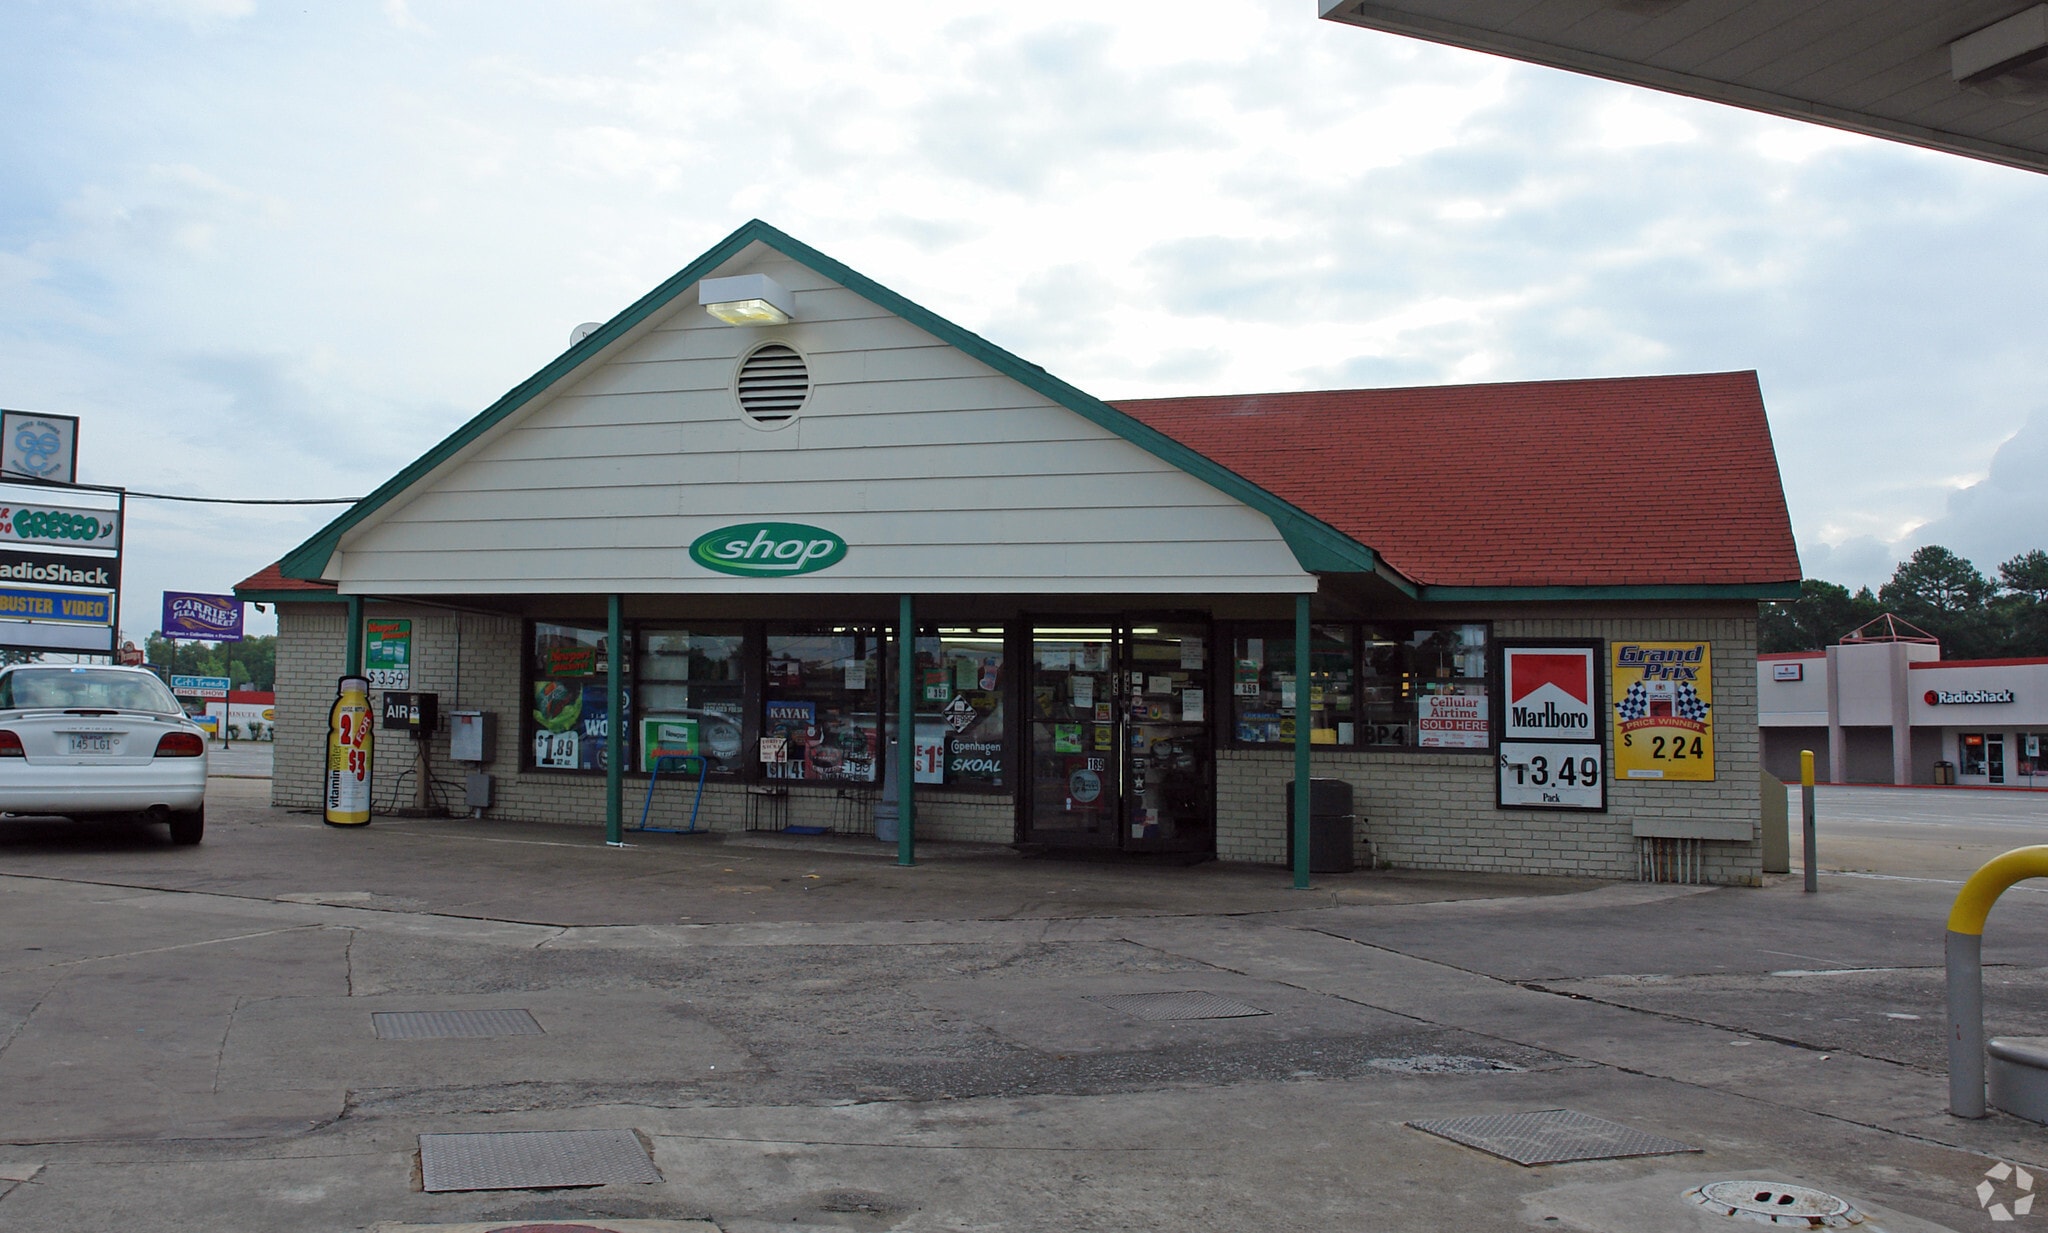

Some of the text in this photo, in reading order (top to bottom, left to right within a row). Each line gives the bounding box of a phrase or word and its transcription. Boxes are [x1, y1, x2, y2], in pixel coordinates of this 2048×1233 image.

[718, 529, 834, 570] shop
[0, 595, 104, 617] BUSTER VIDEO
[173, 600, 238, 620] CARRIE'S
[173, 610, 237, 627] FLEA MARKET
[1618, 645, 1705, 665] Grand
[1642, 663, 1700, 680] Prix
[175, 677, 194, 687] Citi
[1430, 697, 1478, 708] Cellular
[1939, 689, 2014, 705] RadioShack
[386, 704, 408, 719] AIR
[770, 708, 810, 720] KAYAK
[1430, 708, 1478, 718] Airtime
[1512, 701, 1588, 729] Marlboro
[341, 714, 352, 745] 2
[357, 717, 371, 742] FOR
[584, 718, 629, 737] WOF
[1422, 720, 1488, 730] SOLD HERE
[1626, 718, 1701, 731] PRICE WINNER
[72, 739, 89, 750] 145
[538, 734, 573, 765] $1.89
[951, 739, 1001, 755] Copenhagen
[1623, 734, 1704, 762] $ 2.24
[349, 749, 365, 782] $3
[951, 758, 1002, 773] SKOAL
[328, 744, 343, 809] vitaminwater
[1542, 792, 1561, 803] Pack
